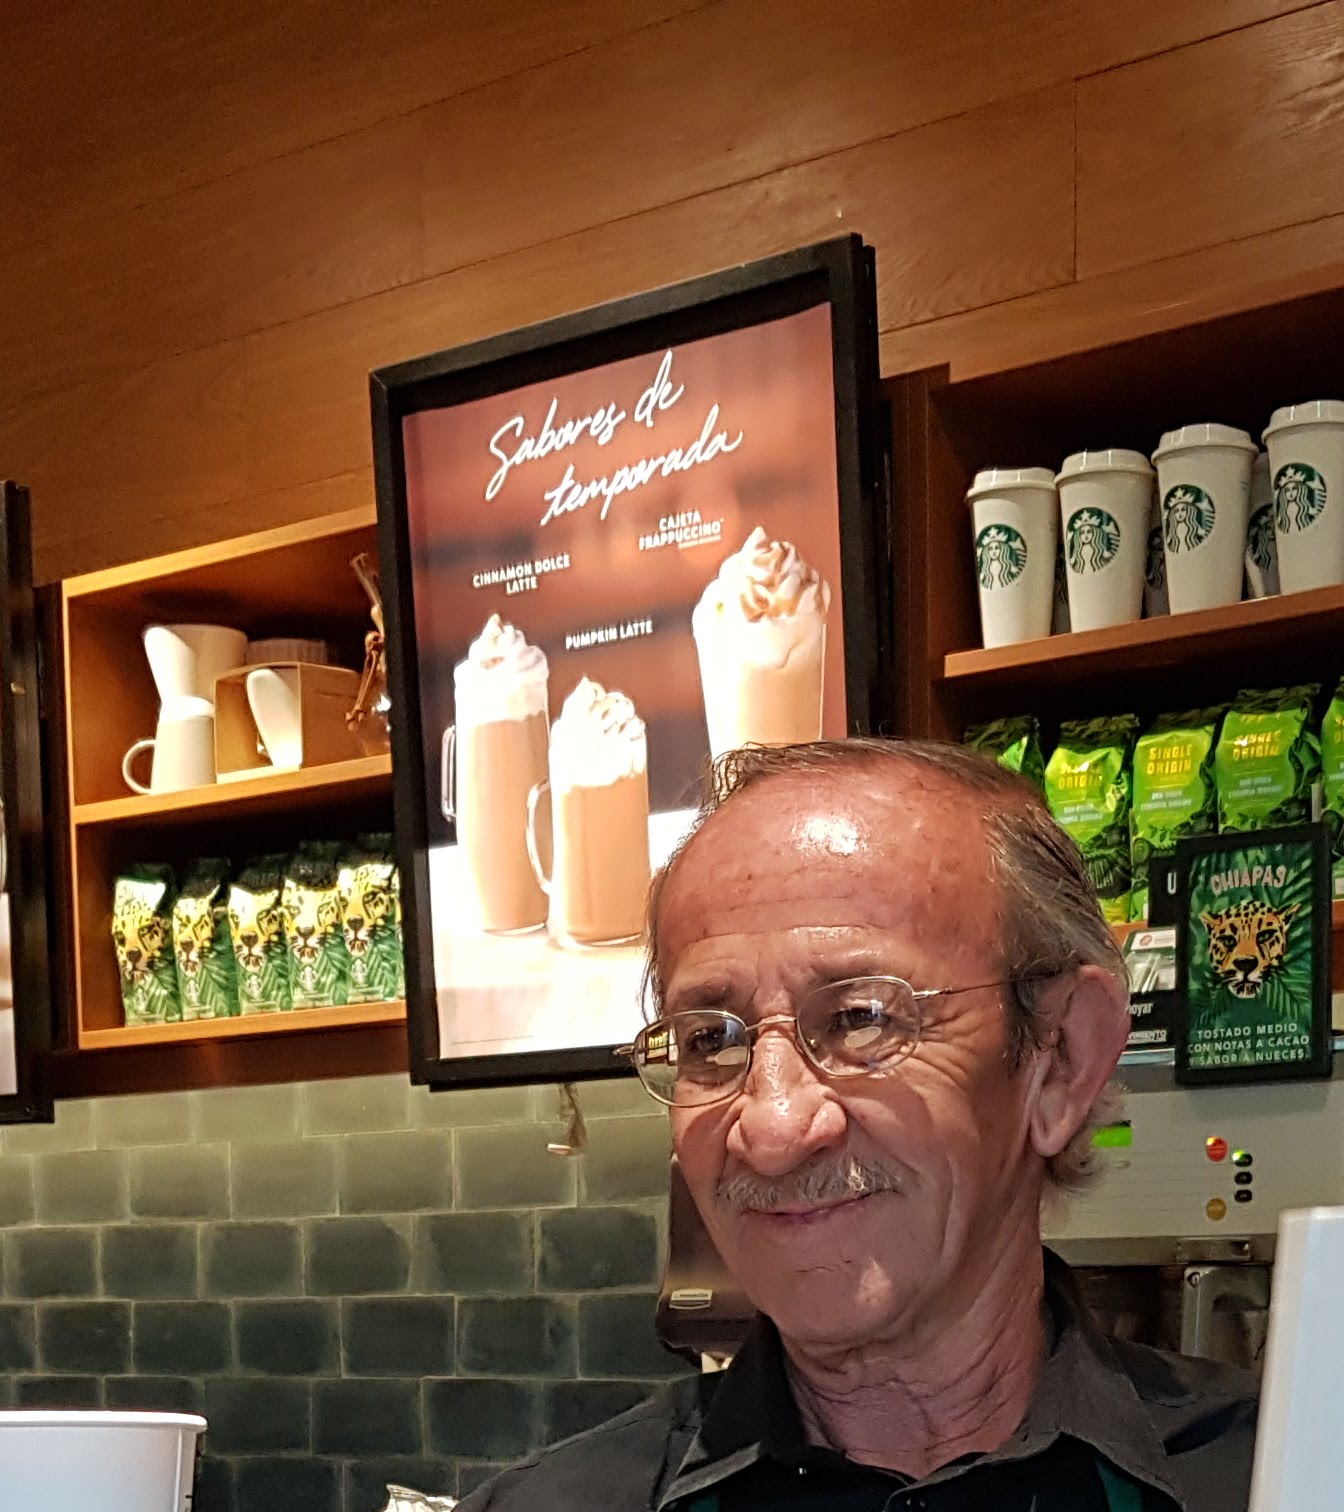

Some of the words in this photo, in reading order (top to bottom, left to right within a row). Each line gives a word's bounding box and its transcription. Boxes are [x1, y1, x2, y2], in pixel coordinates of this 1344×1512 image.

[485, 398, 626, 501] Sabores
[634, 348, 685, 428] de
[540, 403, 744, 527] temporada
[659, 509, 701, 531] CAJETA
[472, 562, 533, 588] CINNAMON
[534, 554, 570, 575] DOLCE
[506, 576, 538, 595] LATTE
[565, 629, 617, 651] PUMPKIN
[620, 620, 653, 640] LATTE
[1210, 864, 1288, 896] CHIAPAS
[1197, 1025, 1252, 1040] TOSTADO
[1256, 1022, 1298, 1035] MEDIO
[1188, 1042, 1210, 1054] CON
[1214, 1039, 1252, 1051] NOTAS
[1256, 1038, 1264, 1048] A
[1268, 1035, 1310, 1047] CACAO
[1199, 1053, 1238, 1066] SABOR
